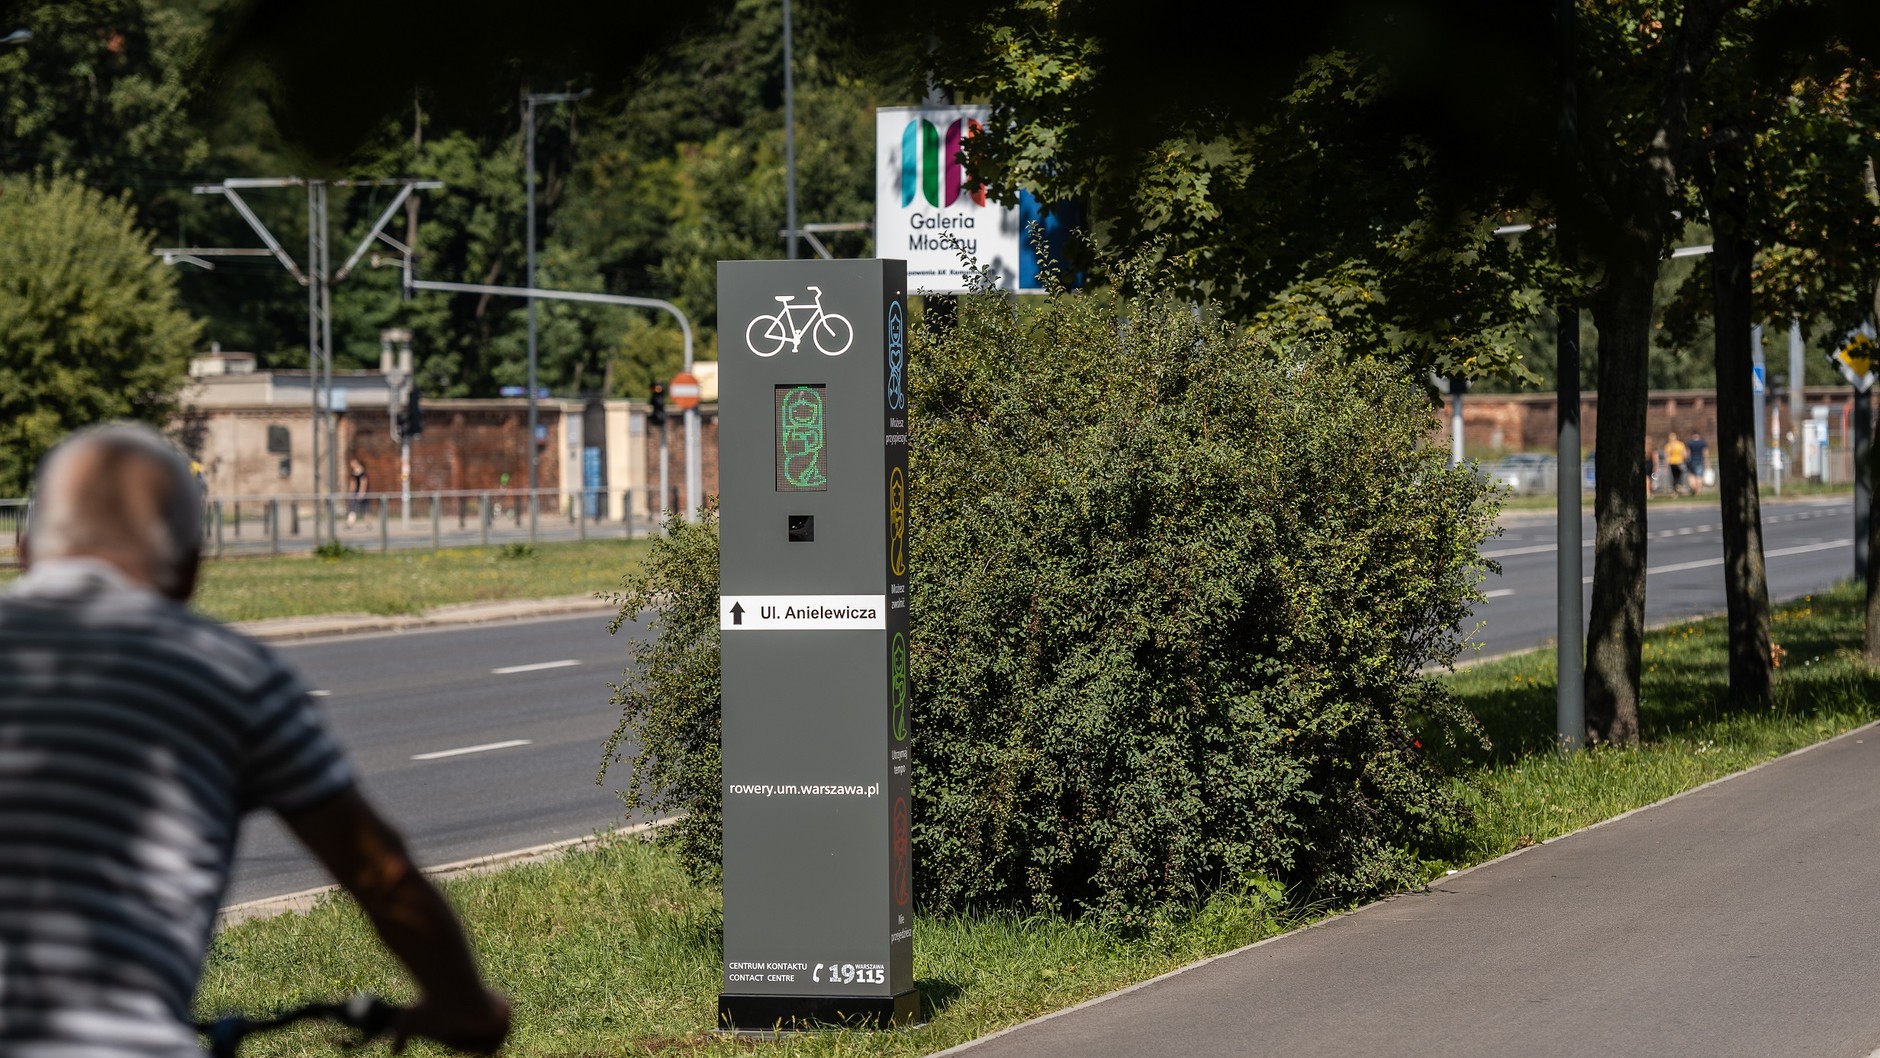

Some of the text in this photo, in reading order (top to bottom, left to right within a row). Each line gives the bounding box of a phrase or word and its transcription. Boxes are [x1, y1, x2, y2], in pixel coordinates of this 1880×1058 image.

[910, 213, 975, 229] Galeria
[760, 606, 876, 619] Ul. Anielewicza
[729, 782, 880, 797] rowery.um.warszawa.pl
[728, 962, 808, 971] CENTRUM KONTAKTU
[729, 973, 795, 982] CONTACT CENTRE
[829, 963, 885, 985] 19 115
